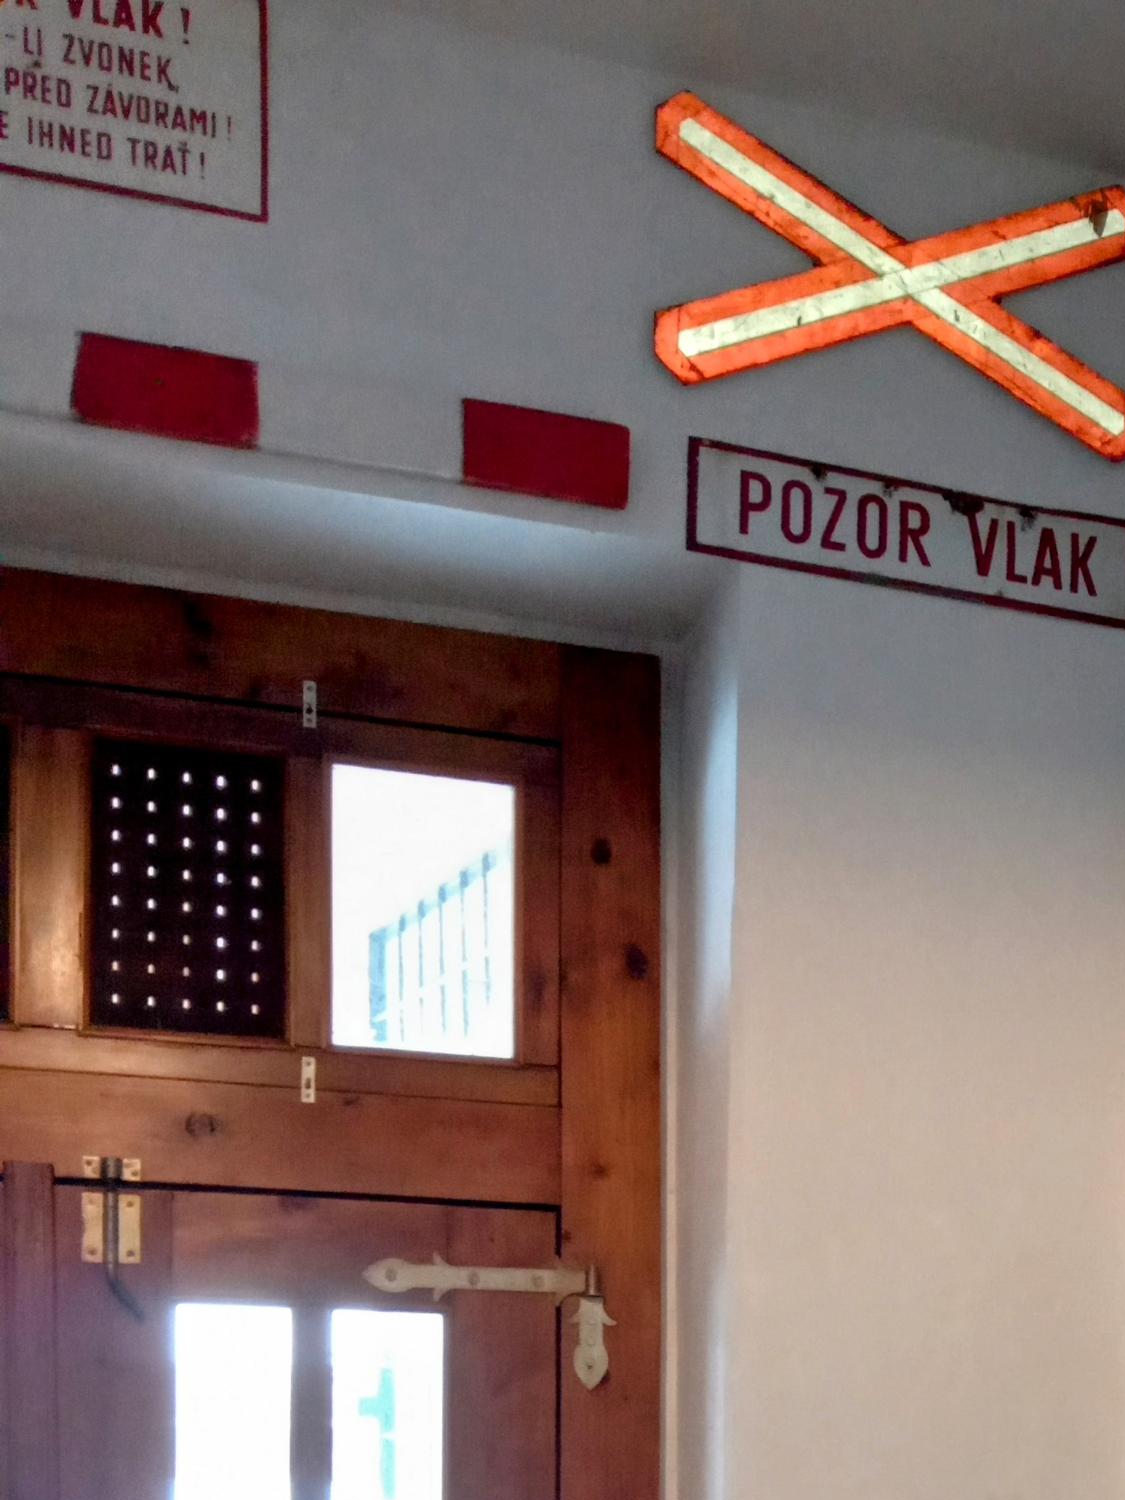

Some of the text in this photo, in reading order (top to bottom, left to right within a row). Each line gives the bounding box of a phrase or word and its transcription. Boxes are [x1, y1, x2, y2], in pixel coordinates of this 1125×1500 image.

[5, 60, 72, 108] PŘED
[27, 116, 112, 160] IHNED
[738, 469, 1098, 597] POZOR VLAK
